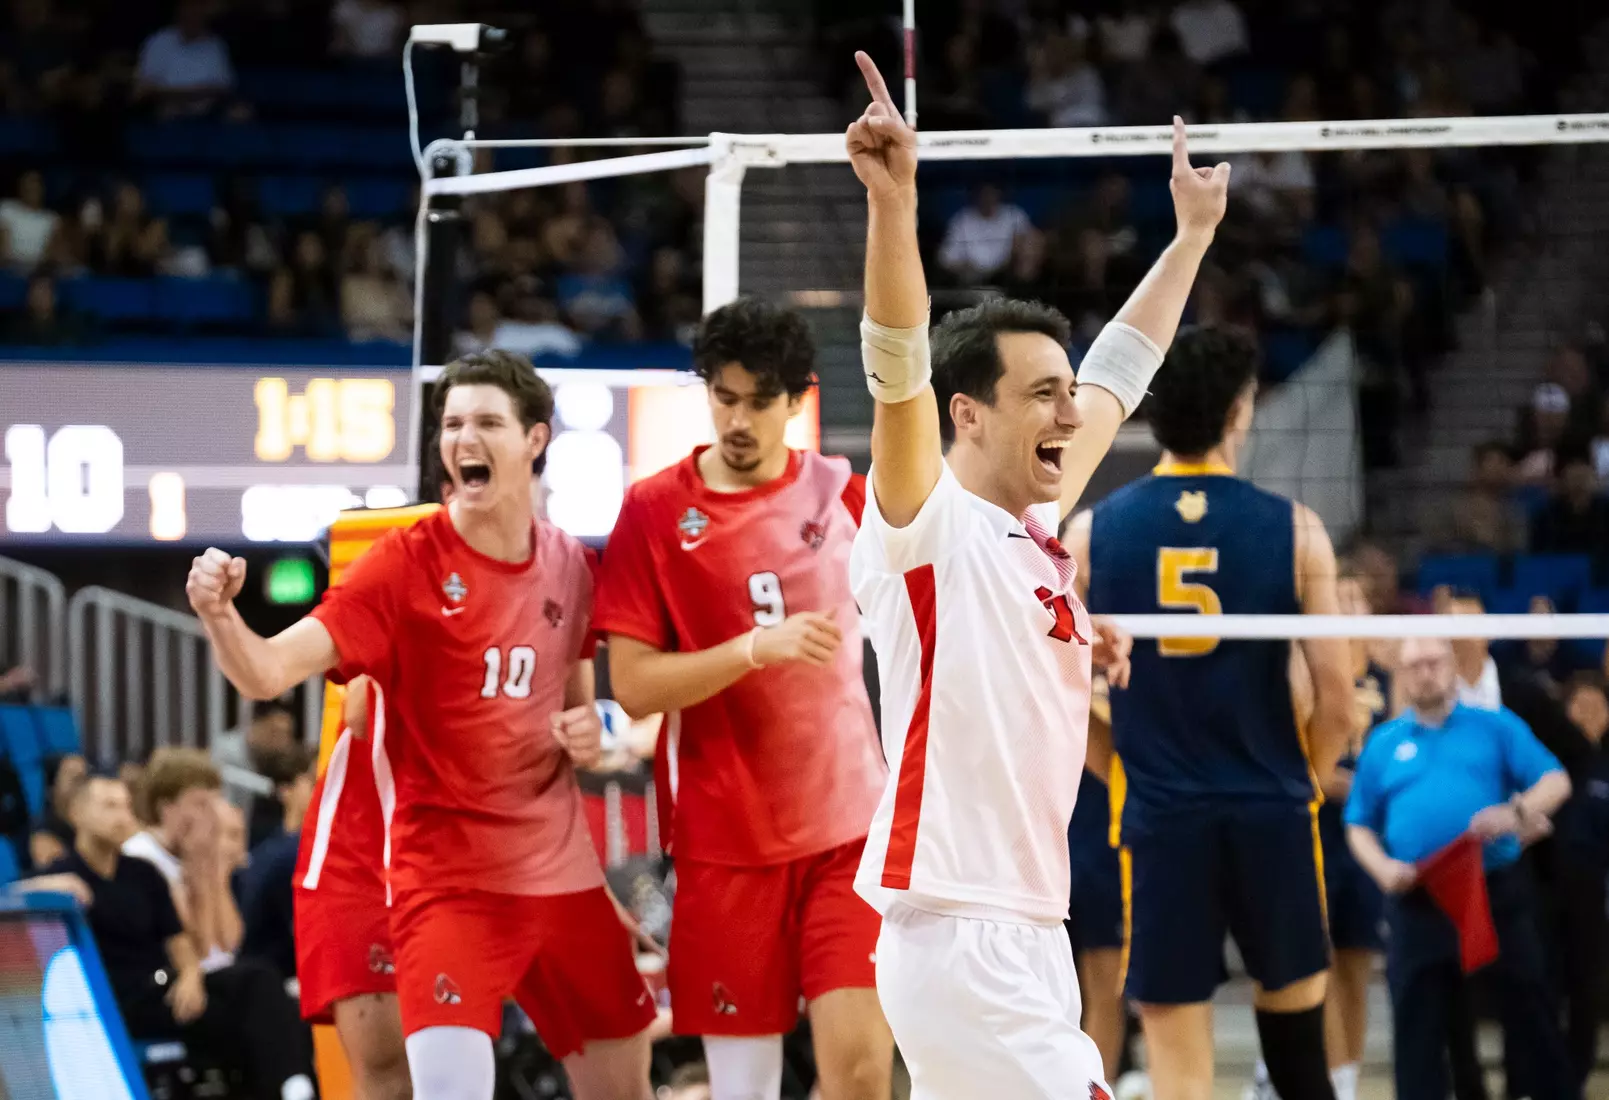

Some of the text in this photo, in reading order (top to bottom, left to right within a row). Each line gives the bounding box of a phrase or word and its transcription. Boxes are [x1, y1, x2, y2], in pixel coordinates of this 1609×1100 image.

[253, 377, 396, 463] 1:15
[5, 424, 125, 534] 10
[747, 570, 788, 628] 9
[1157, 546, 1223, 658] 5
[479, 644, 537, 699] 10
